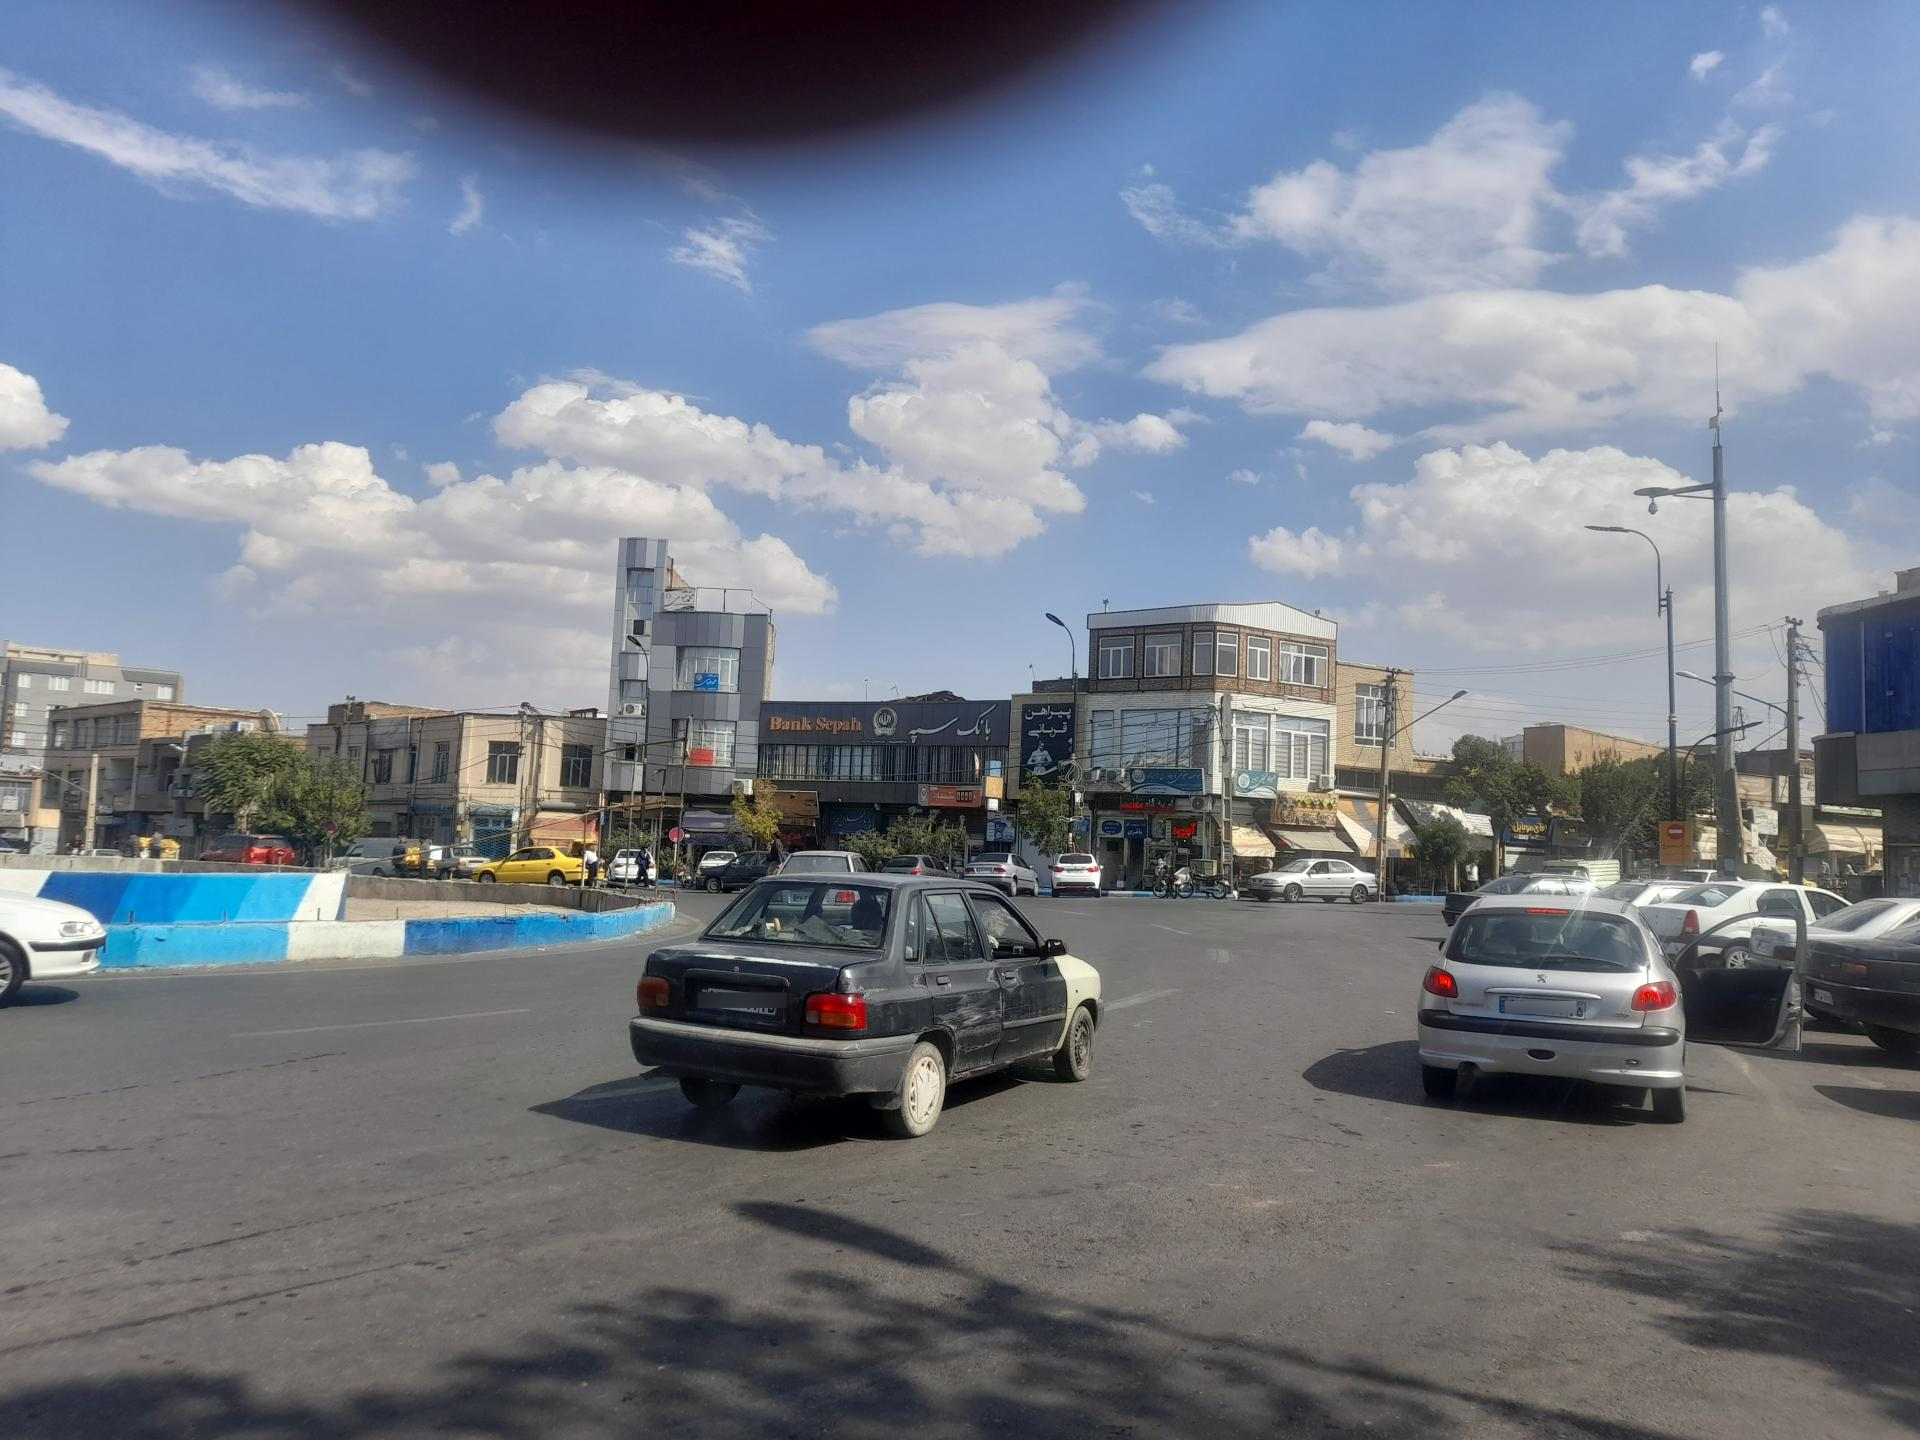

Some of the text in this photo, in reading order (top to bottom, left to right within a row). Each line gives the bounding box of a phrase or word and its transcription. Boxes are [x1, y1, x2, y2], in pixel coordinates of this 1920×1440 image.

[1025, 705, 1072, 720] پیراهن
[769, 715, 862, 735] Bank Sepah
[908, 703, 997, 744] بانک سپه
[1028, 721, 1068, 738] قربانی
